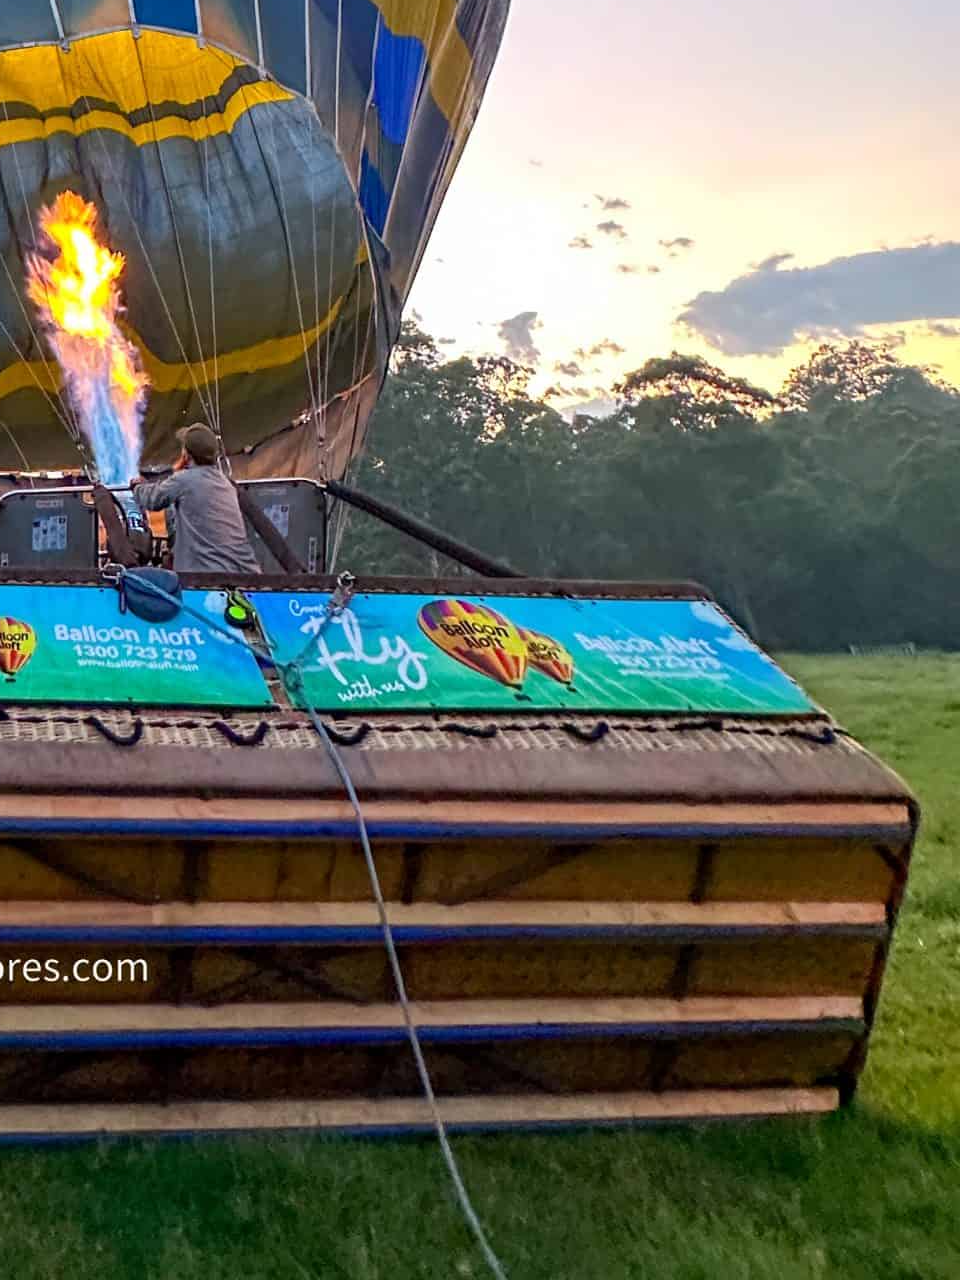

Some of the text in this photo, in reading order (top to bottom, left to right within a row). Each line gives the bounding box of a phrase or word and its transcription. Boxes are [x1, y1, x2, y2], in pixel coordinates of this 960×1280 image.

[54, 623, 206, 646] Balloon Aloft
[440, 620, 509, 638] Balloon
[73, 644, 119, 658] 1300
[300, 608, 428, 690] Fly
[464, 634, 504, 649] Aloft
[337, 674, 406, 702] with us
